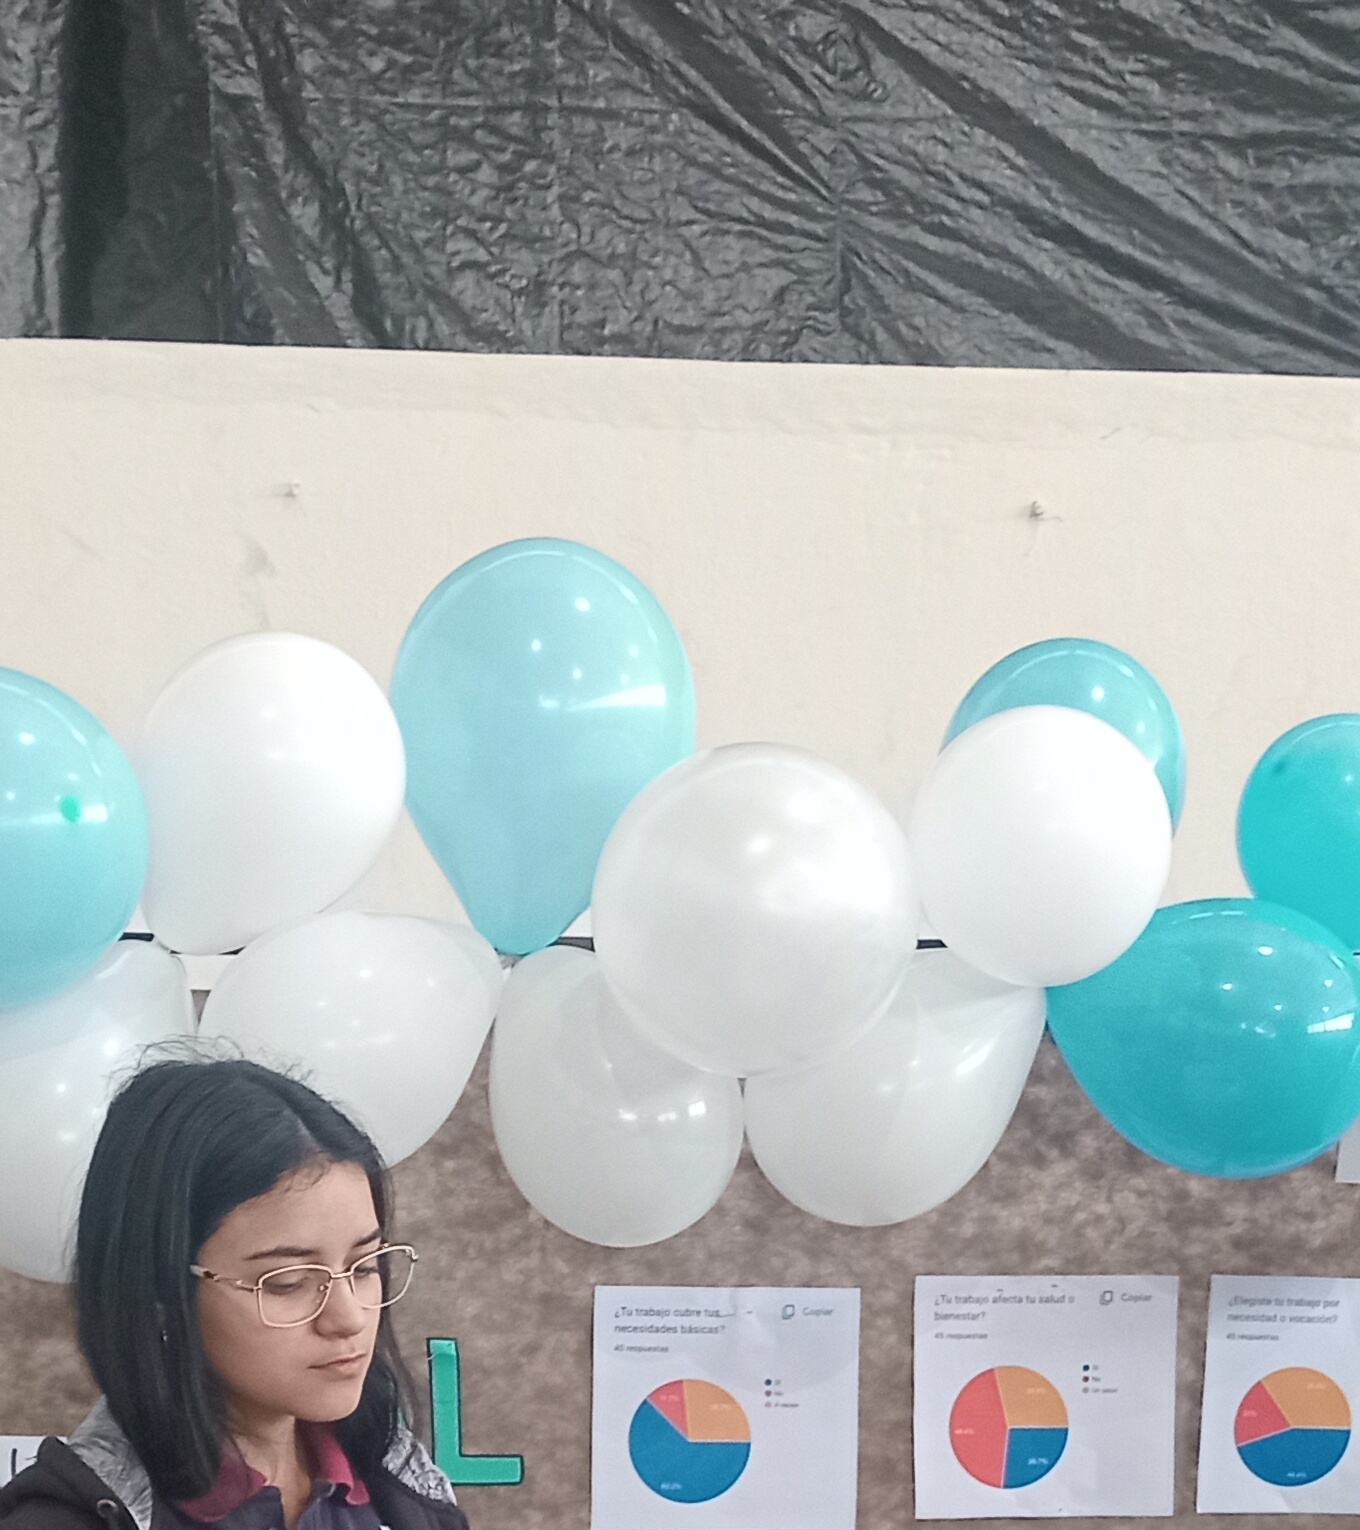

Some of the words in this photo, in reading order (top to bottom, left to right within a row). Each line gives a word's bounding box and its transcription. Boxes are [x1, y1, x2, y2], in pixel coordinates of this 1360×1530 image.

[934, 1294, 952, 1306] ¿Tu
[954, 1294, 989, 1306] trabajo
[992, 1294, 1023, 1304] afecta
[1026, 1295, 1036, 1304] tu
[1038, 1294, 1066, 1304] salud
[1121, 1293, 1152, 1303] Copiar
[1274, 1298, 1285, 1307] tu
[1286, 1297, 1321, 1310] trabajo
[1323, 1299, 1340, 1310] por
[614, 1306, 633, 1318] ¿Tu
[635, 1306, 671, 1318] trabajo
[673, 1307, 702, 1317] cubre
[704, 1308, 721, 1317] tus
[802, 1307, 834, 1318] Copiar
[934, 1310, 986, 1321] bienestar?
[1227, 1313, 1277, 1323] necesidad
[1289, 1312, 1338, 1324] vocación?
[614, 1323, 678, 1334] necesidades
[680, 1322, 725, 1334] básicas?
